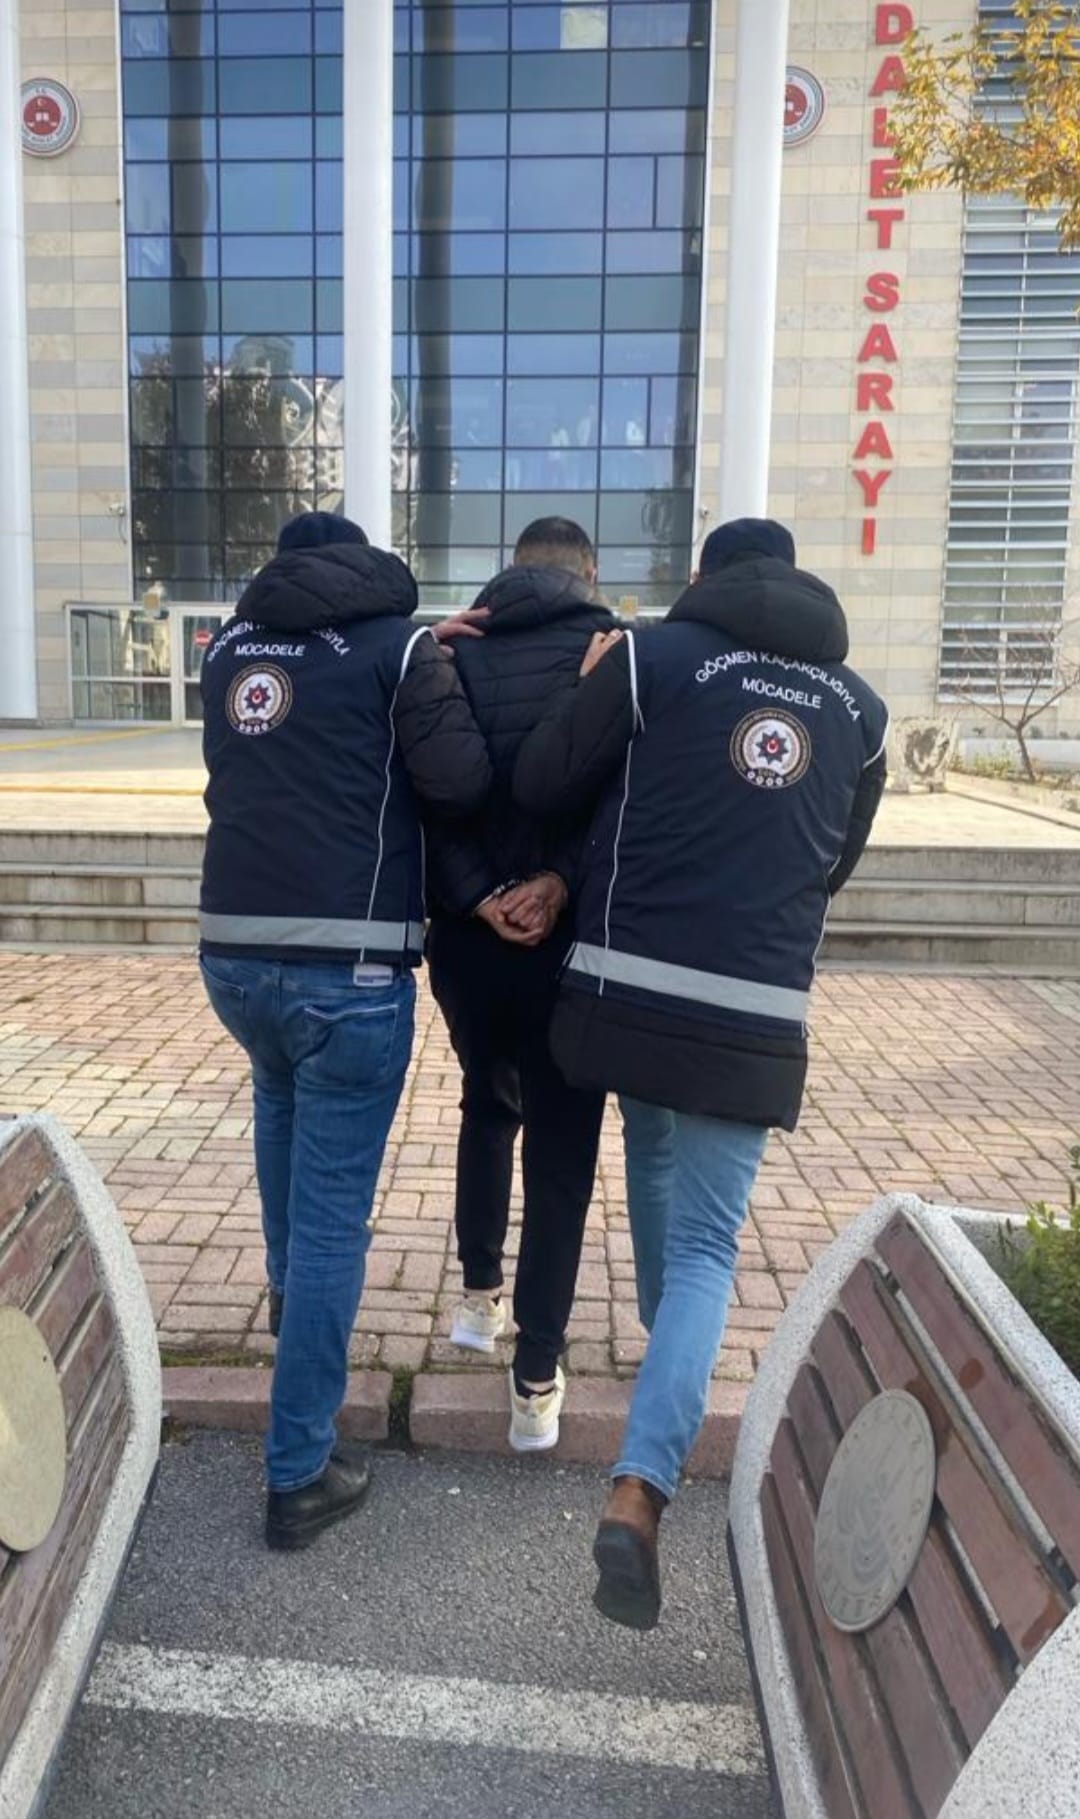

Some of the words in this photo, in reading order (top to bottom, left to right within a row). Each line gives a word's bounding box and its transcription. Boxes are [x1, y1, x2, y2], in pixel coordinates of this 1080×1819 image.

[852, 272, 900, 555] SARAYI
[234, 642, 305, 656] MÜCADELE
[695, 651, 757, 682] GÖÇMEN
[742, 677, 822, 709] MÜCADELE
